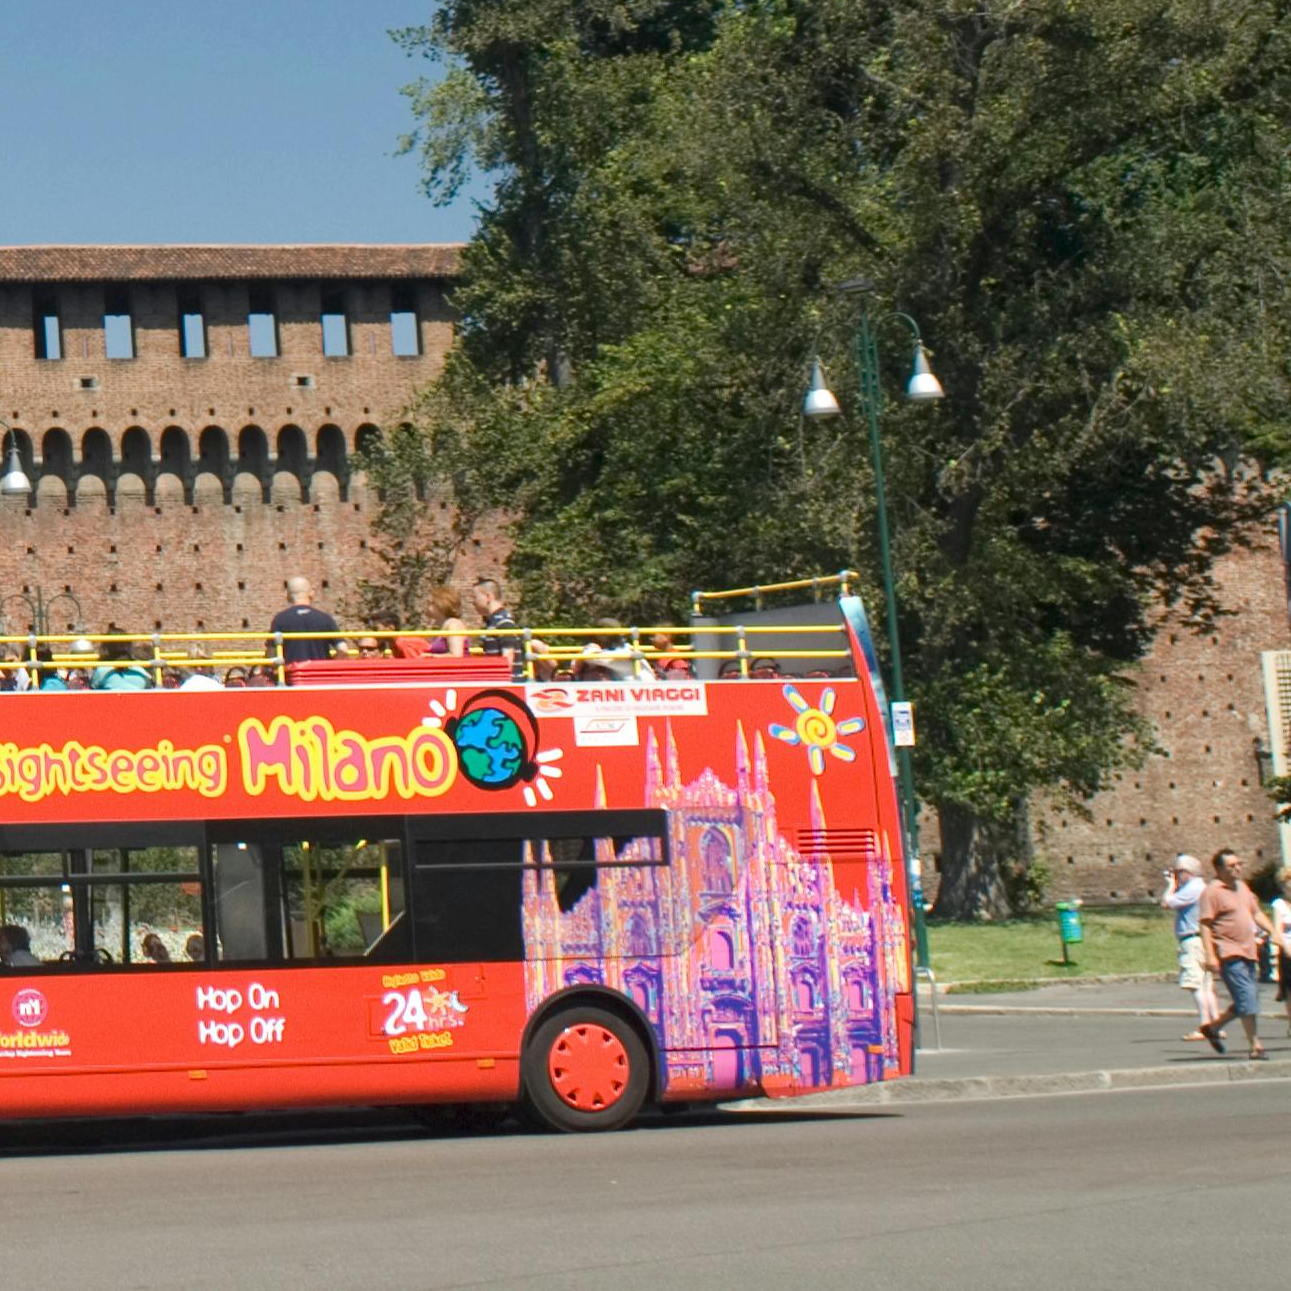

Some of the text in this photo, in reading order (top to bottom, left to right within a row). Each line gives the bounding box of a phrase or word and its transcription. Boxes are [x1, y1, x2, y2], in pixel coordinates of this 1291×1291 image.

[576, 688, 700, 703] ZANI VIAGGI
[238, 715, 458, 801] Milano
[197, 983, 280, 1013] Hop On
[383, 989, 427, 1034] 24
[198, 1017, 286, 1047] Hop Off
